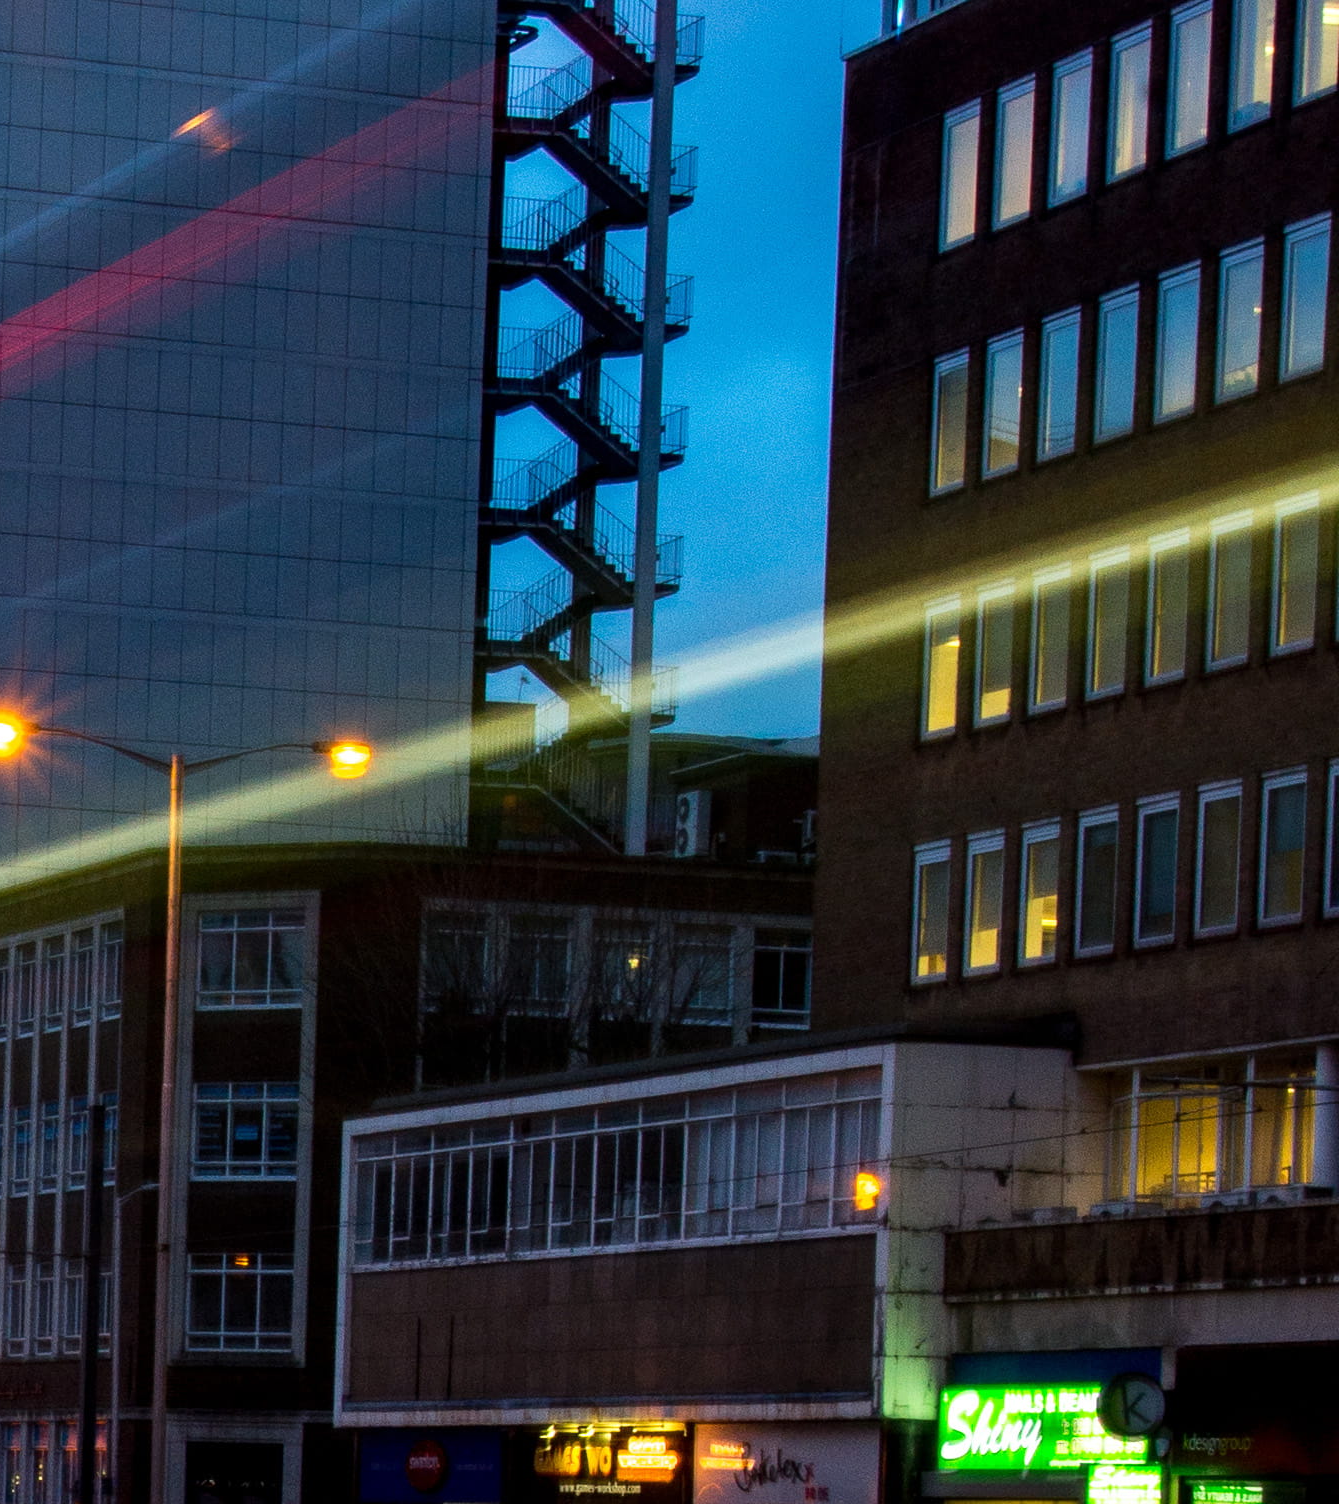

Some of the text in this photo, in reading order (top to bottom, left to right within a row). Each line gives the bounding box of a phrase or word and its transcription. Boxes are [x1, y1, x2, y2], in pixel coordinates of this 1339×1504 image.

[940, 1389, 1043, 1467] Shiny
[1004, 1391, 1044, 1413] NAILS
[1183, 1432, 1252, 1456] kdesigngroup
[559, 1481, 641, 1497] www.games-workshop.com
